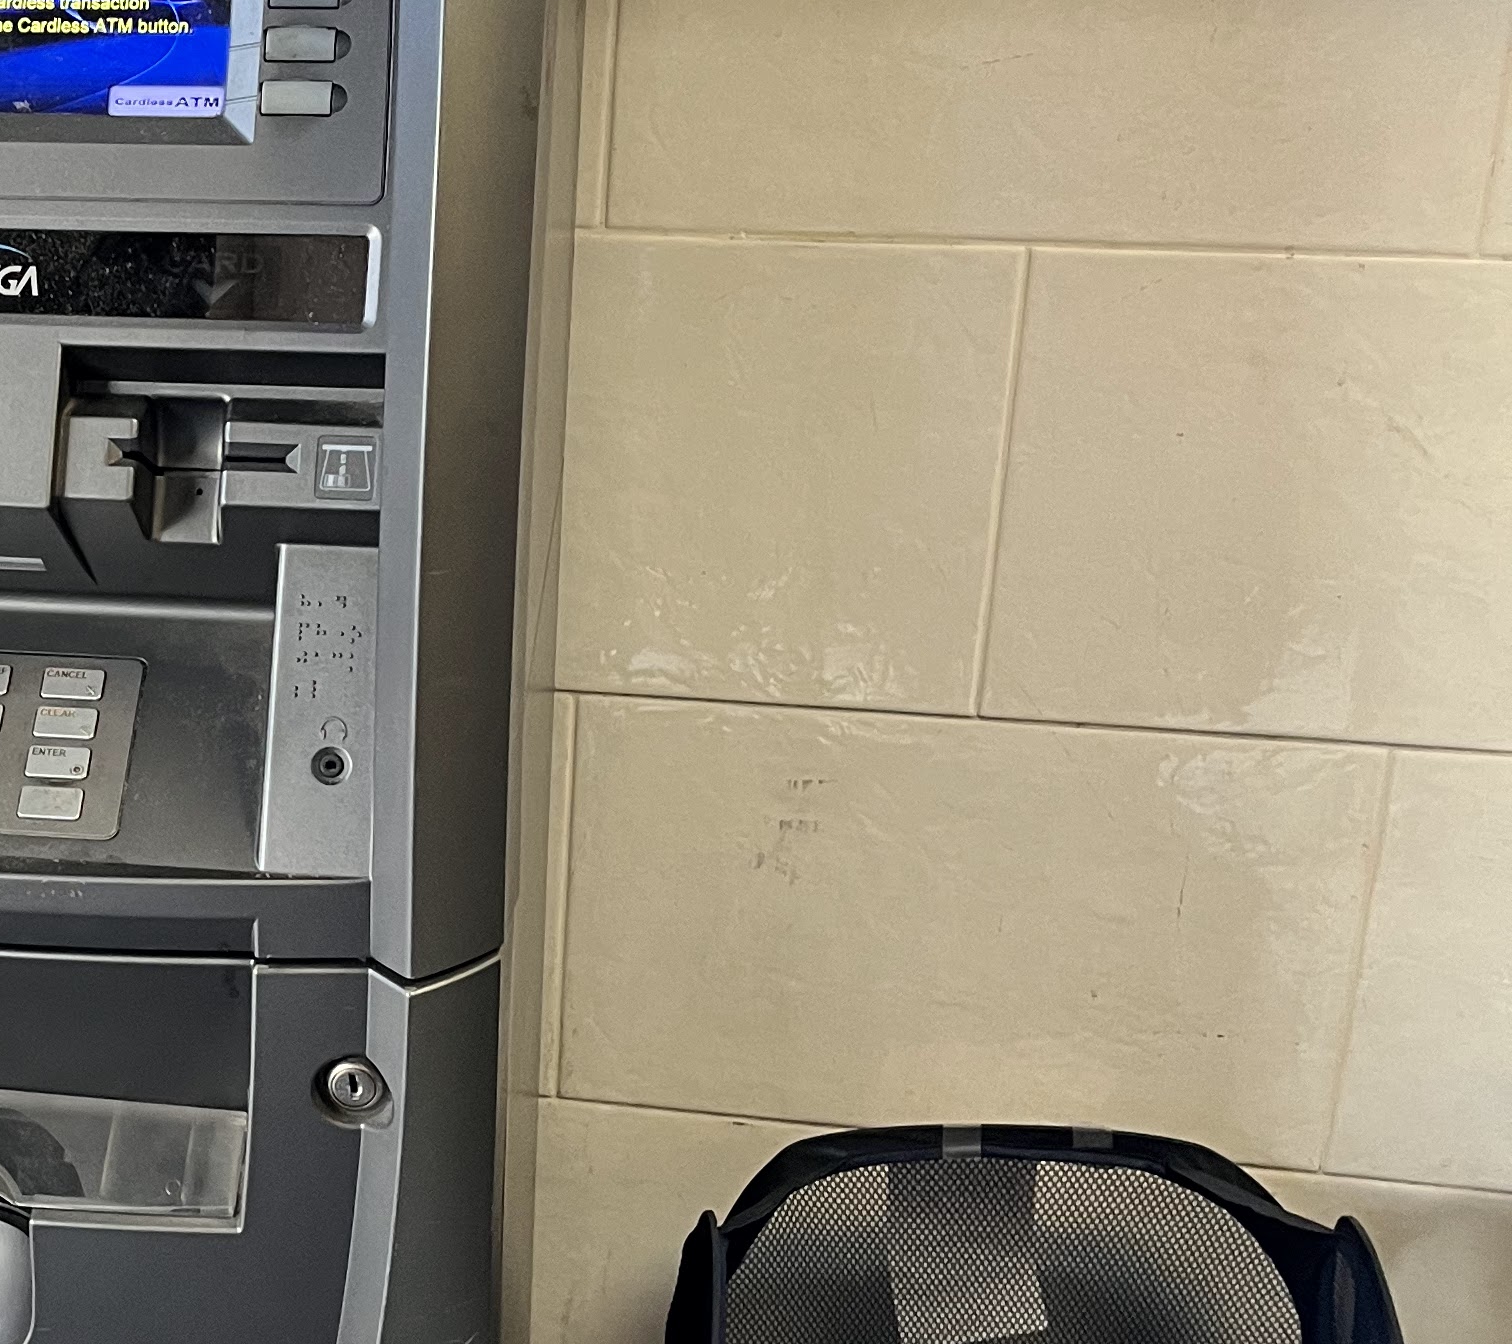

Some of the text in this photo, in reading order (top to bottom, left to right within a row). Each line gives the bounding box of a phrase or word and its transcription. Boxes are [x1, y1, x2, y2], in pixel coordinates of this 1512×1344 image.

[17, 17, 89, 34] Cardless
[93, 17, 134, 34] ATM
[137, 18, 194, 35] button.
[114, 96, 219, 108] Cardless ATM
[46, 669, 87, 679] CANCEL
[40, 708, 75, 719] CLEAR
[31, 747, 67, 757] ENTER
